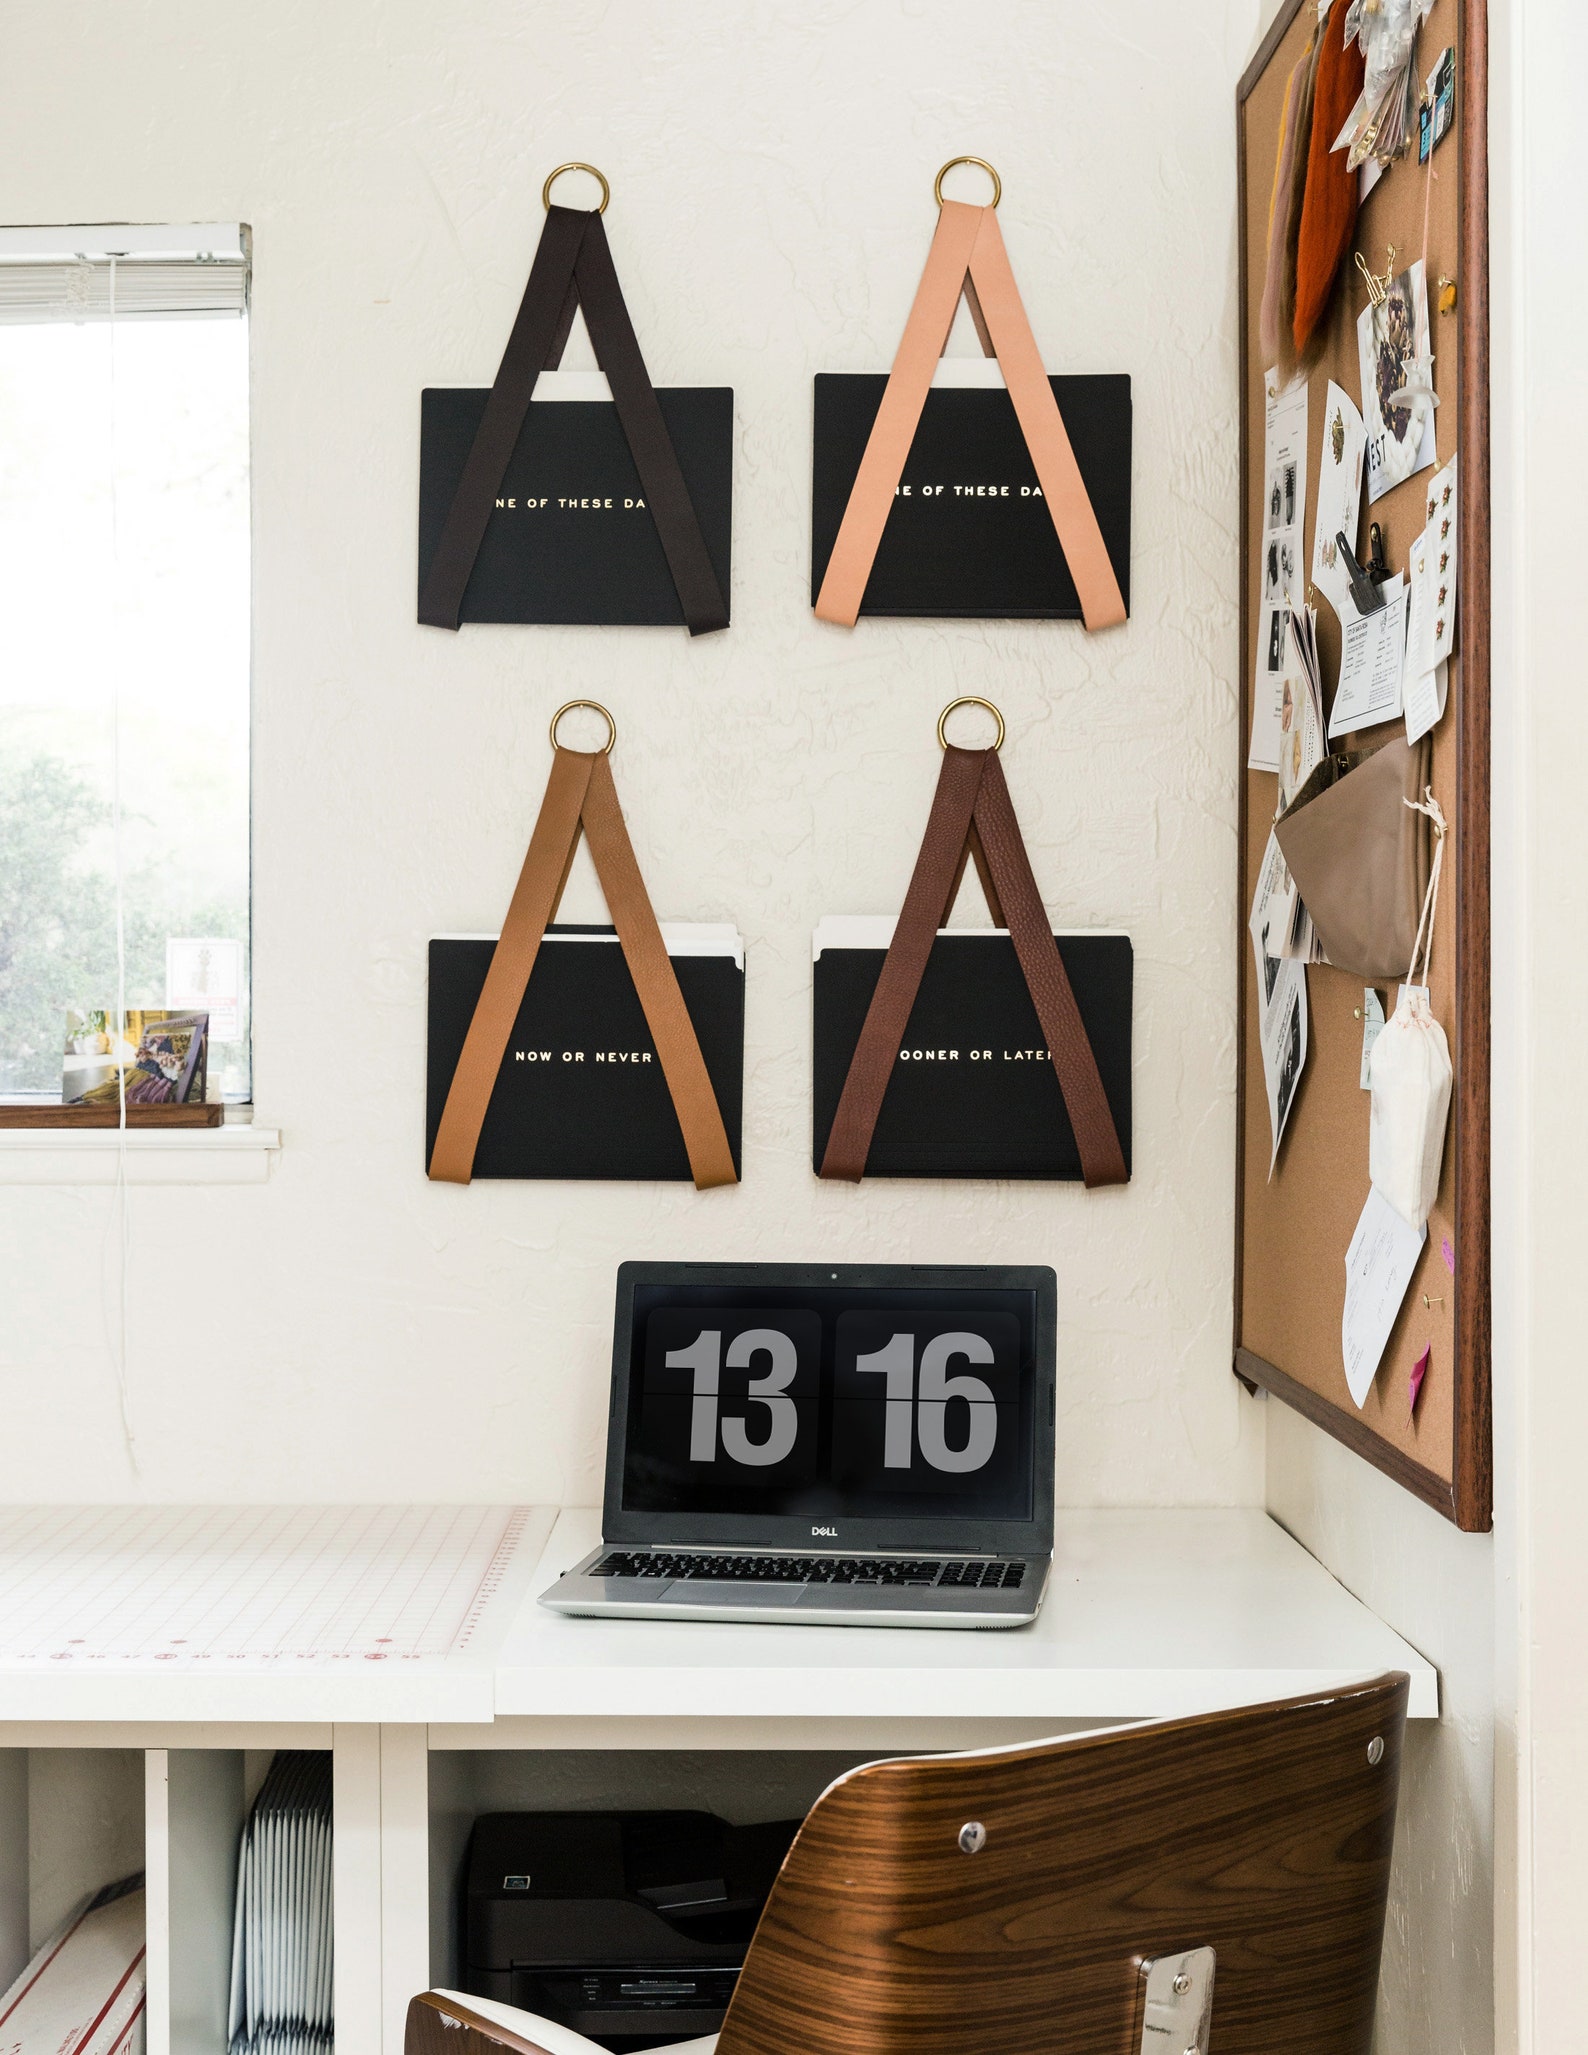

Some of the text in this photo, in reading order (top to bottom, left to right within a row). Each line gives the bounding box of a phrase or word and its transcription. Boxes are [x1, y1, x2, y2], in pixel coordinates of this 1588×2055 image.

[922, 486, 944, 496] OF
[953, 486, 1010, 496] THESE
[1020, 486, 1043, 496] DA
[495, 499, 646, 509] NE OF THESE DA
[515, 1051, 652, 1063] NOW OR NEVER
[899, 1050, 959, 1060] OONER
[969, 1050, 992, 1060] OR
[664, 1329, 998, 1473] 13 16
[811, 1526, 838, 1537] DELL
